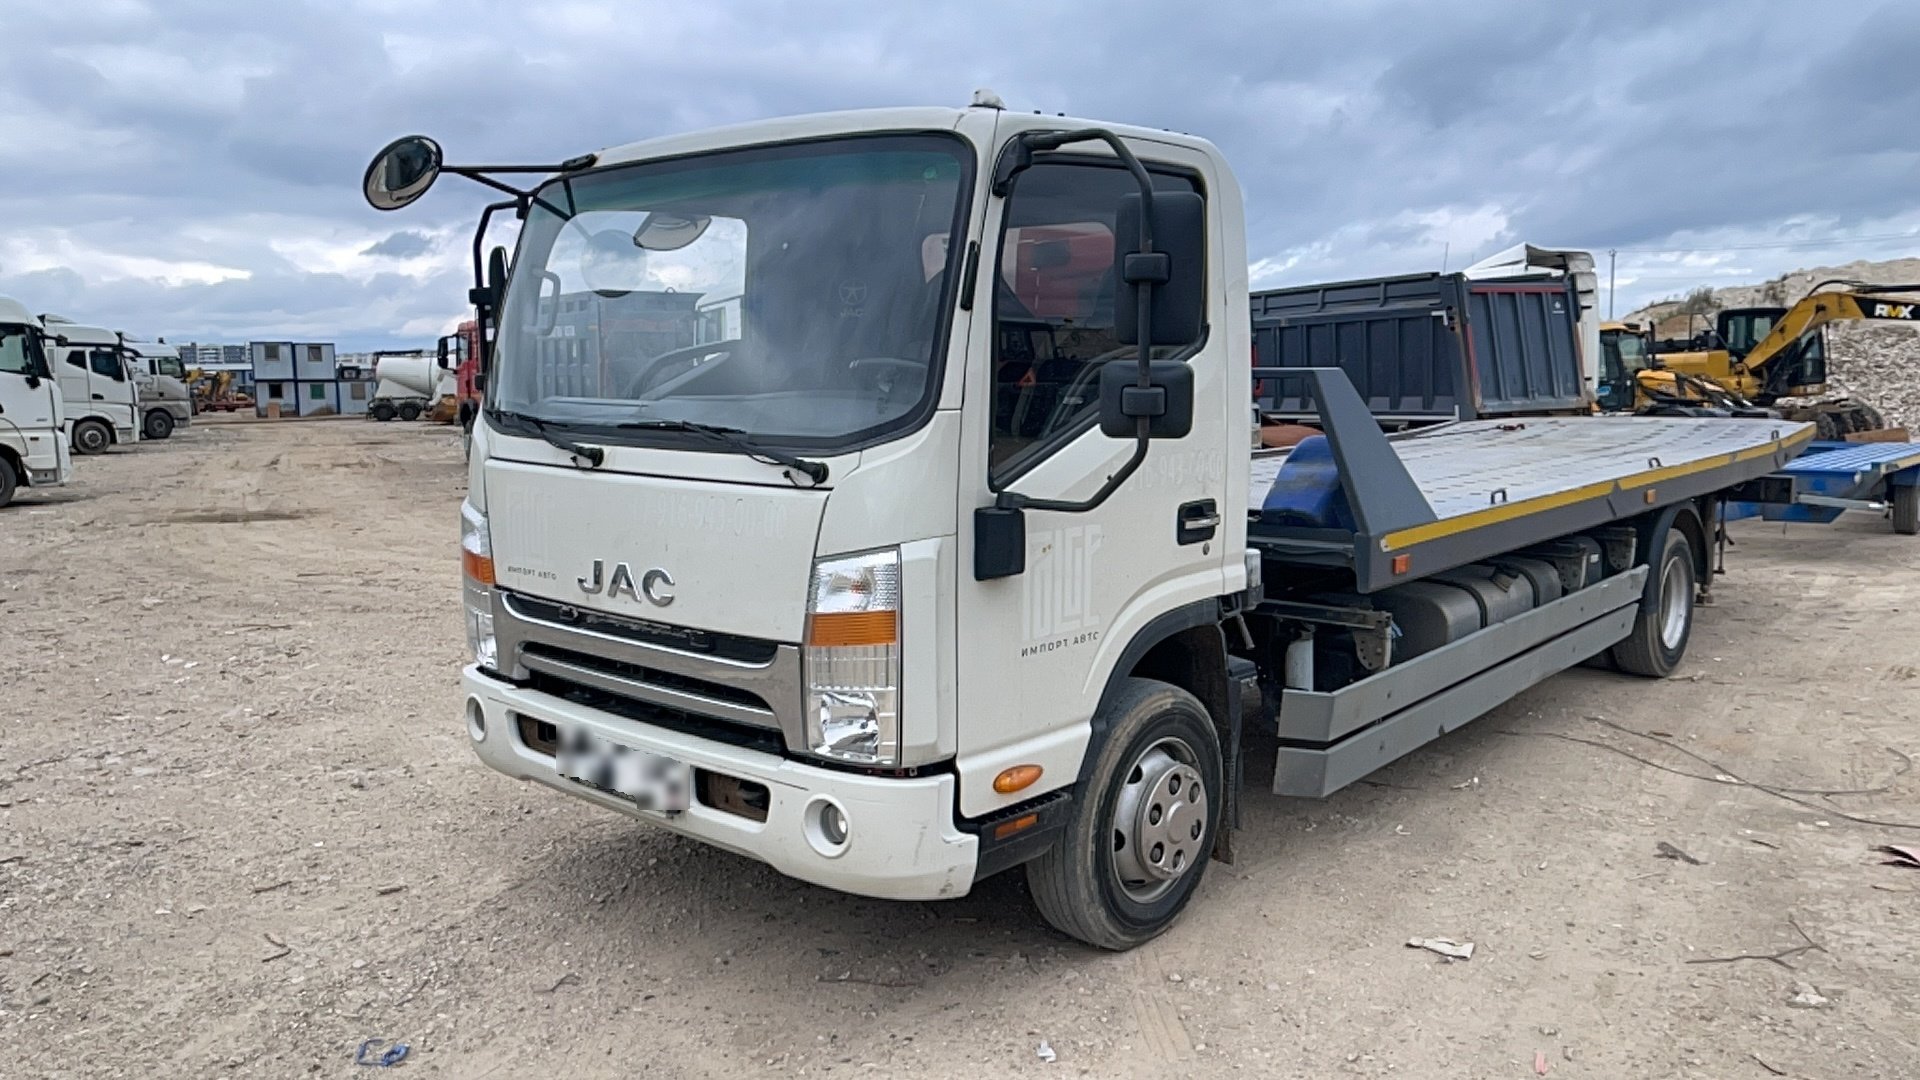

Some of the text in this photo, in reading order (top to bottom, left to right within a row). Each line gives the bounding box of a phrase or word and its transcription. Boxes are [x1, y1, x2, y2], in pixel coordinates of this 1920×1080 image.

[1875, 303, 1916, 319] RMX
[576, 558, 677, 608] JAC
[1020, 638, 1068, 658] ИМПОРТ
